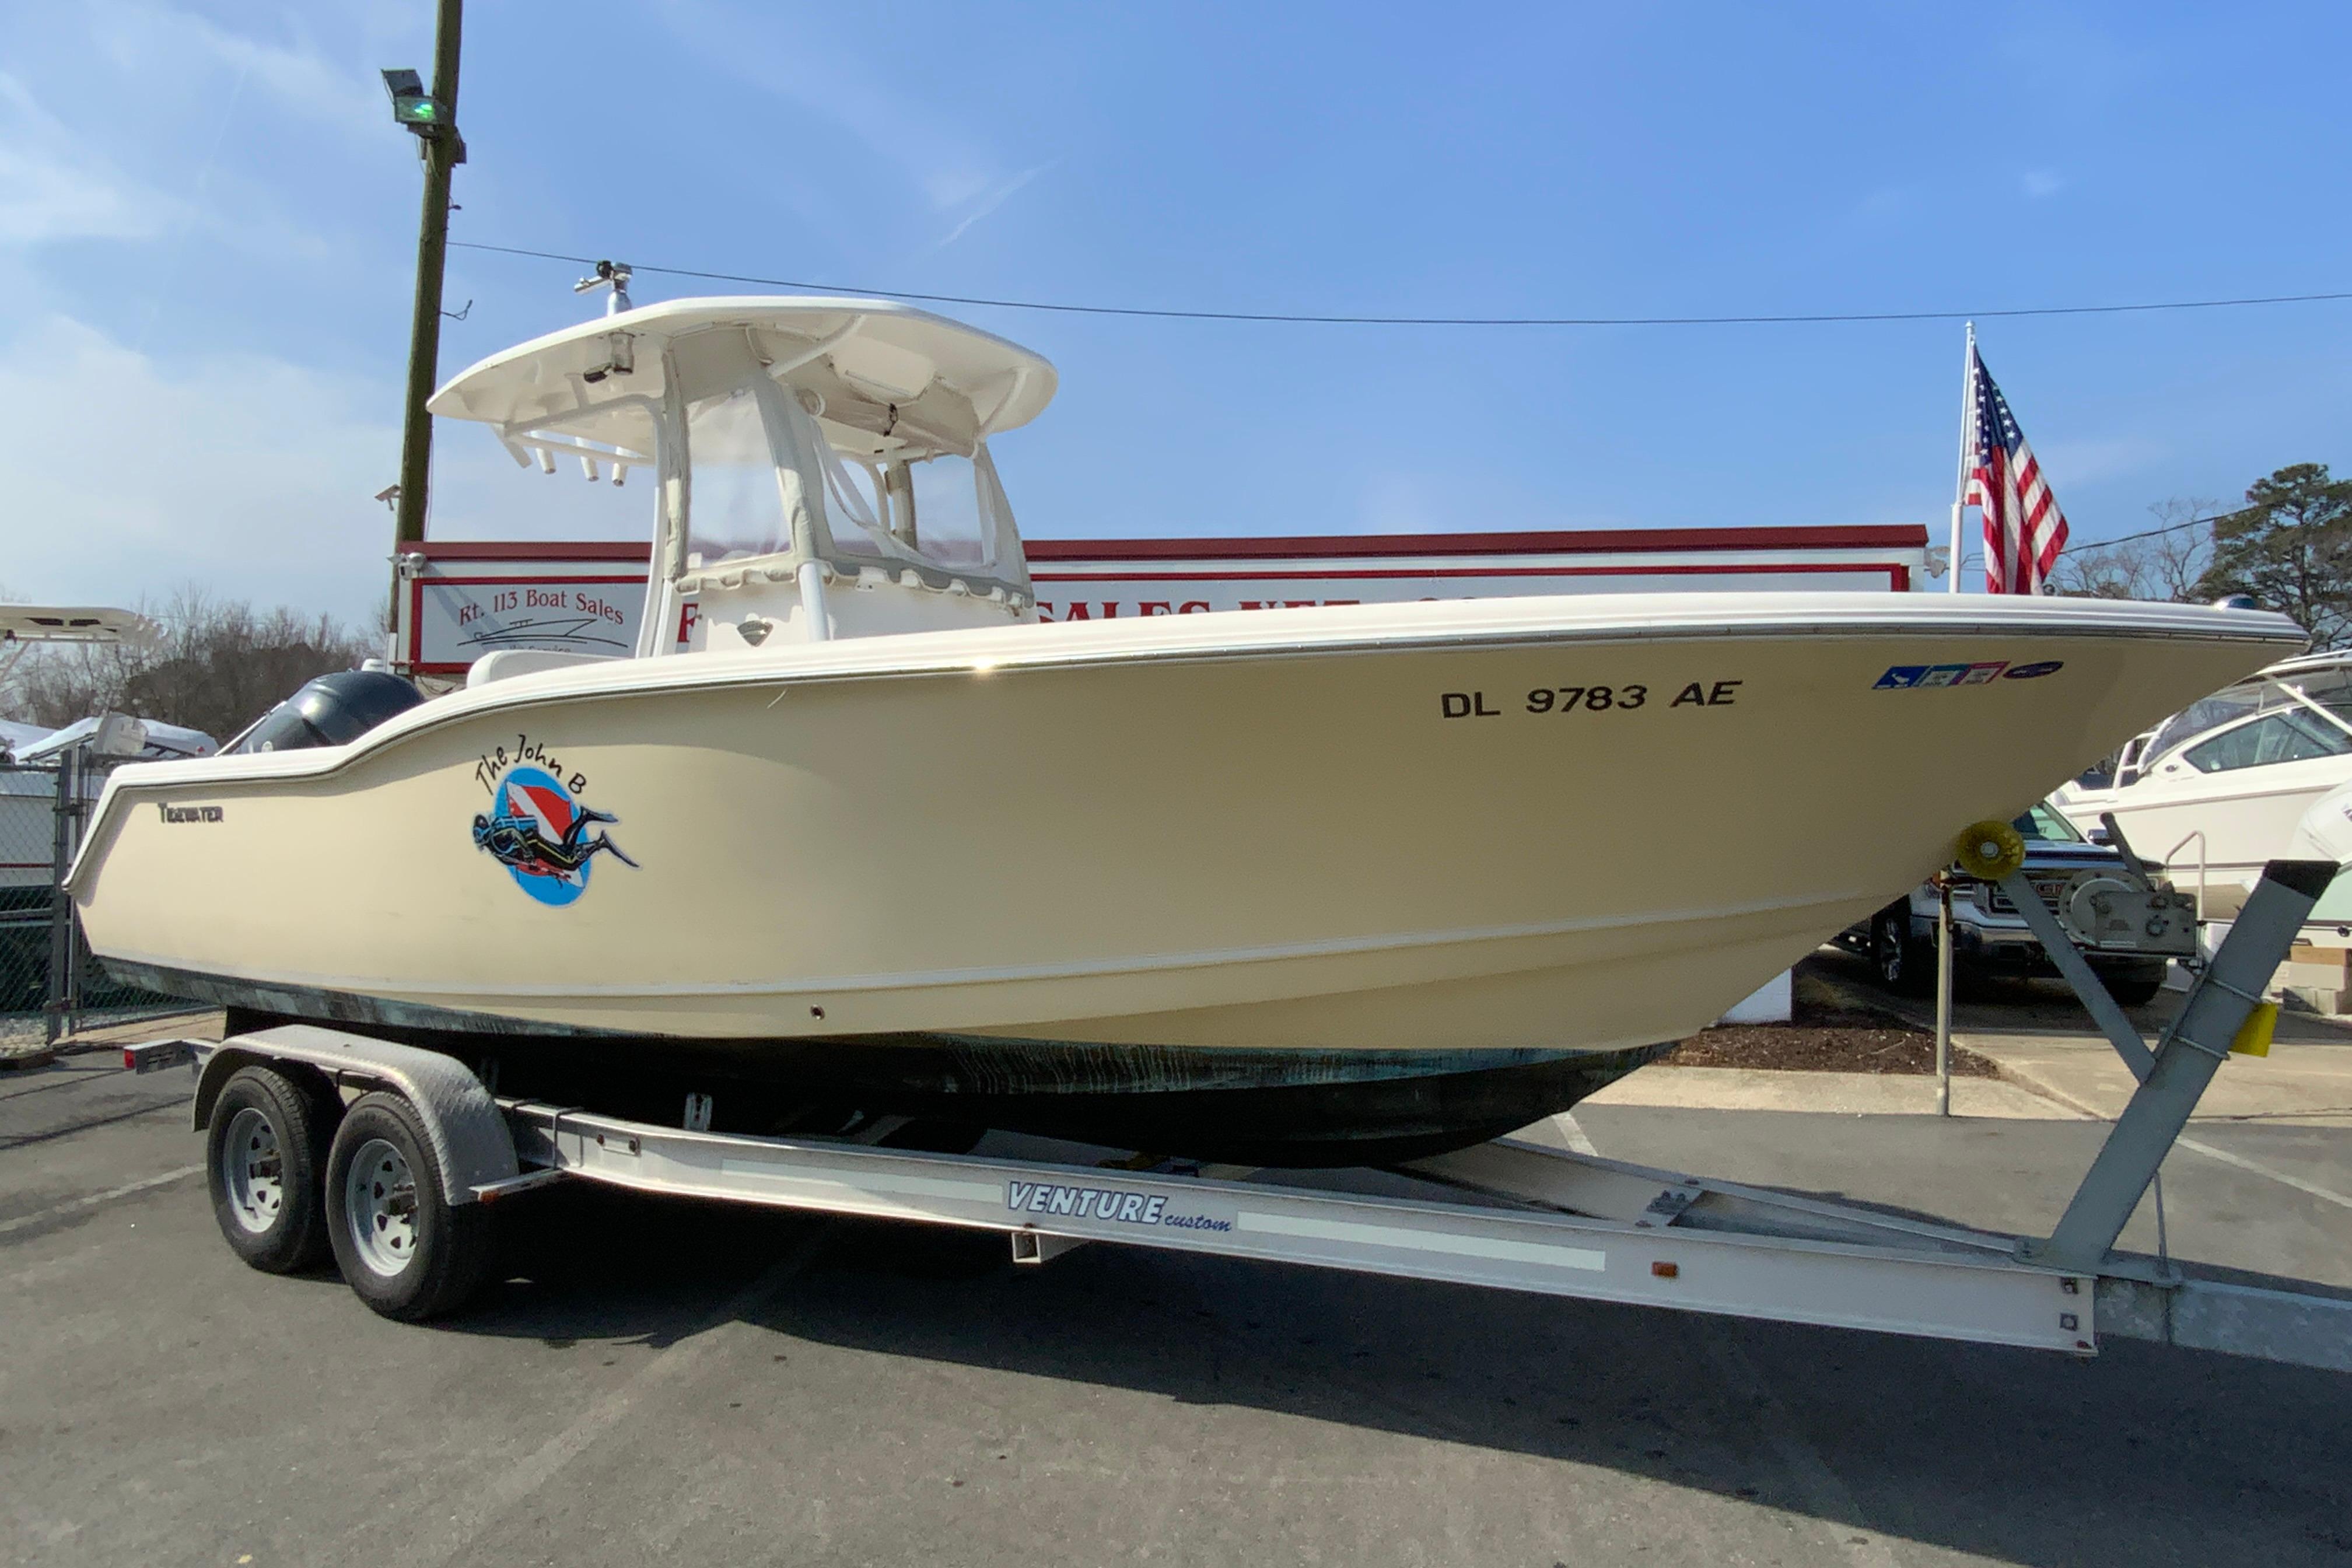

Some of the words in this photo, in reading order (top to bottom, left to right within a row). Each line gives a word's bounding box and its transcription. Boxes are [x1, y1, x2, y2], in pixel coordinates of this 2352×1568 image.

[459, 603, 485, 626] Rt.
[494, 592, 517, 612] 113
[526, 589, 567, 608] Boat
[576, 593, 624, 625] Sales
[1441, 692, 1501, 719] DL
[1525, 685, 1648, 713] 9783
[1669, 680, 1744, 708] AE
[475, 746, 508, 796] The
[514, 734, 562, 778] John
[568, 773, 587, 794] B
[1007, 1181, 1169, 1224] VENTURE
[1164, 1214, 1232, 1233] custom
